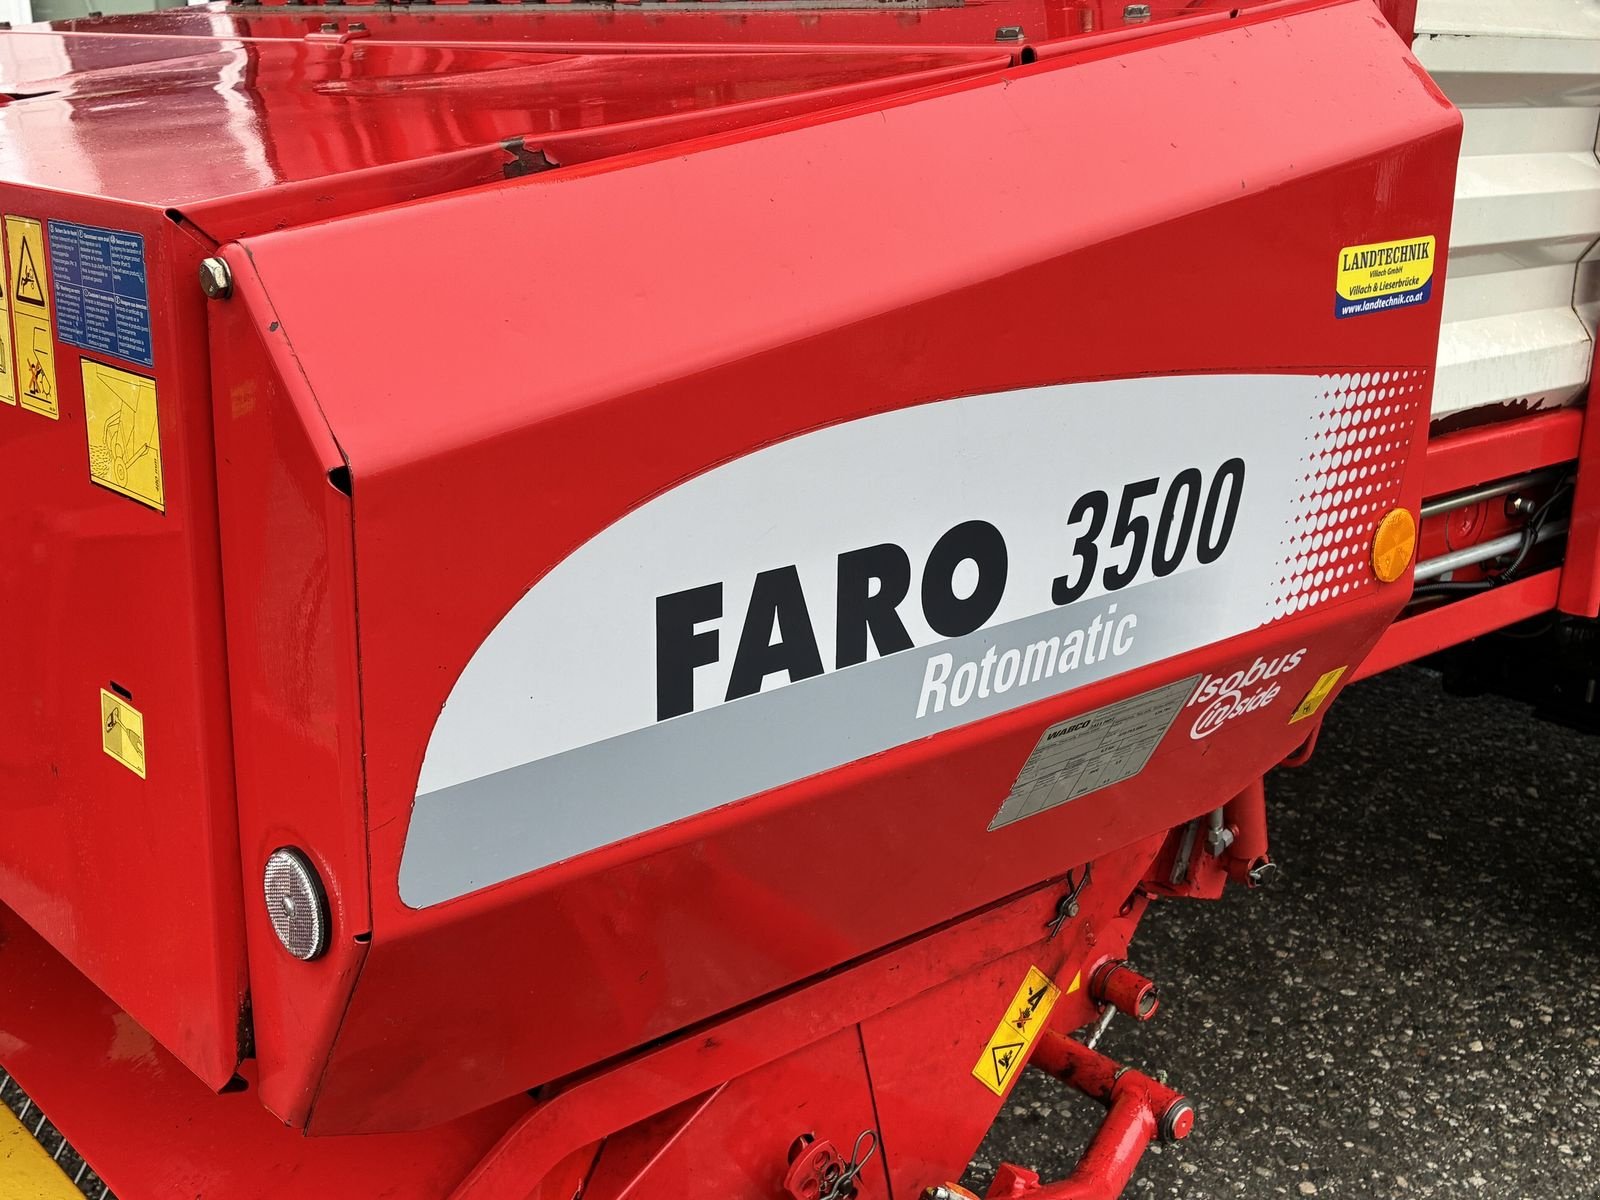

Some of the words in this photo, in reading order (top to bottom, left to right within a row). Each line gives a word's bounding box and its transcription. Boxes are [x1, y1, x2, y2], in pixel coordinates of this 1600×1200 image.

[1343, 242, 1430, 272] LANDTECHNIK
[1369, 270, 1387, 278] Villach
[1387, 266, 1403, 276] GmbH
[1349, 282, 1372, 296] Villach
[1372, 283, 1378, 292] &
[1379, 277, 1420, 291] Lieserbrücke
[1342, 292, 1423, 315] www.landtechnik.co.at
[656, 520, 1008, 722] FARO
[1051, 457, 1246, 606] 3500
[915, 603, 1138, 719] Rotomatic
[1186, 648, 1307, 707] Isobus
[1047, 719, 1091, 741] WABCO
